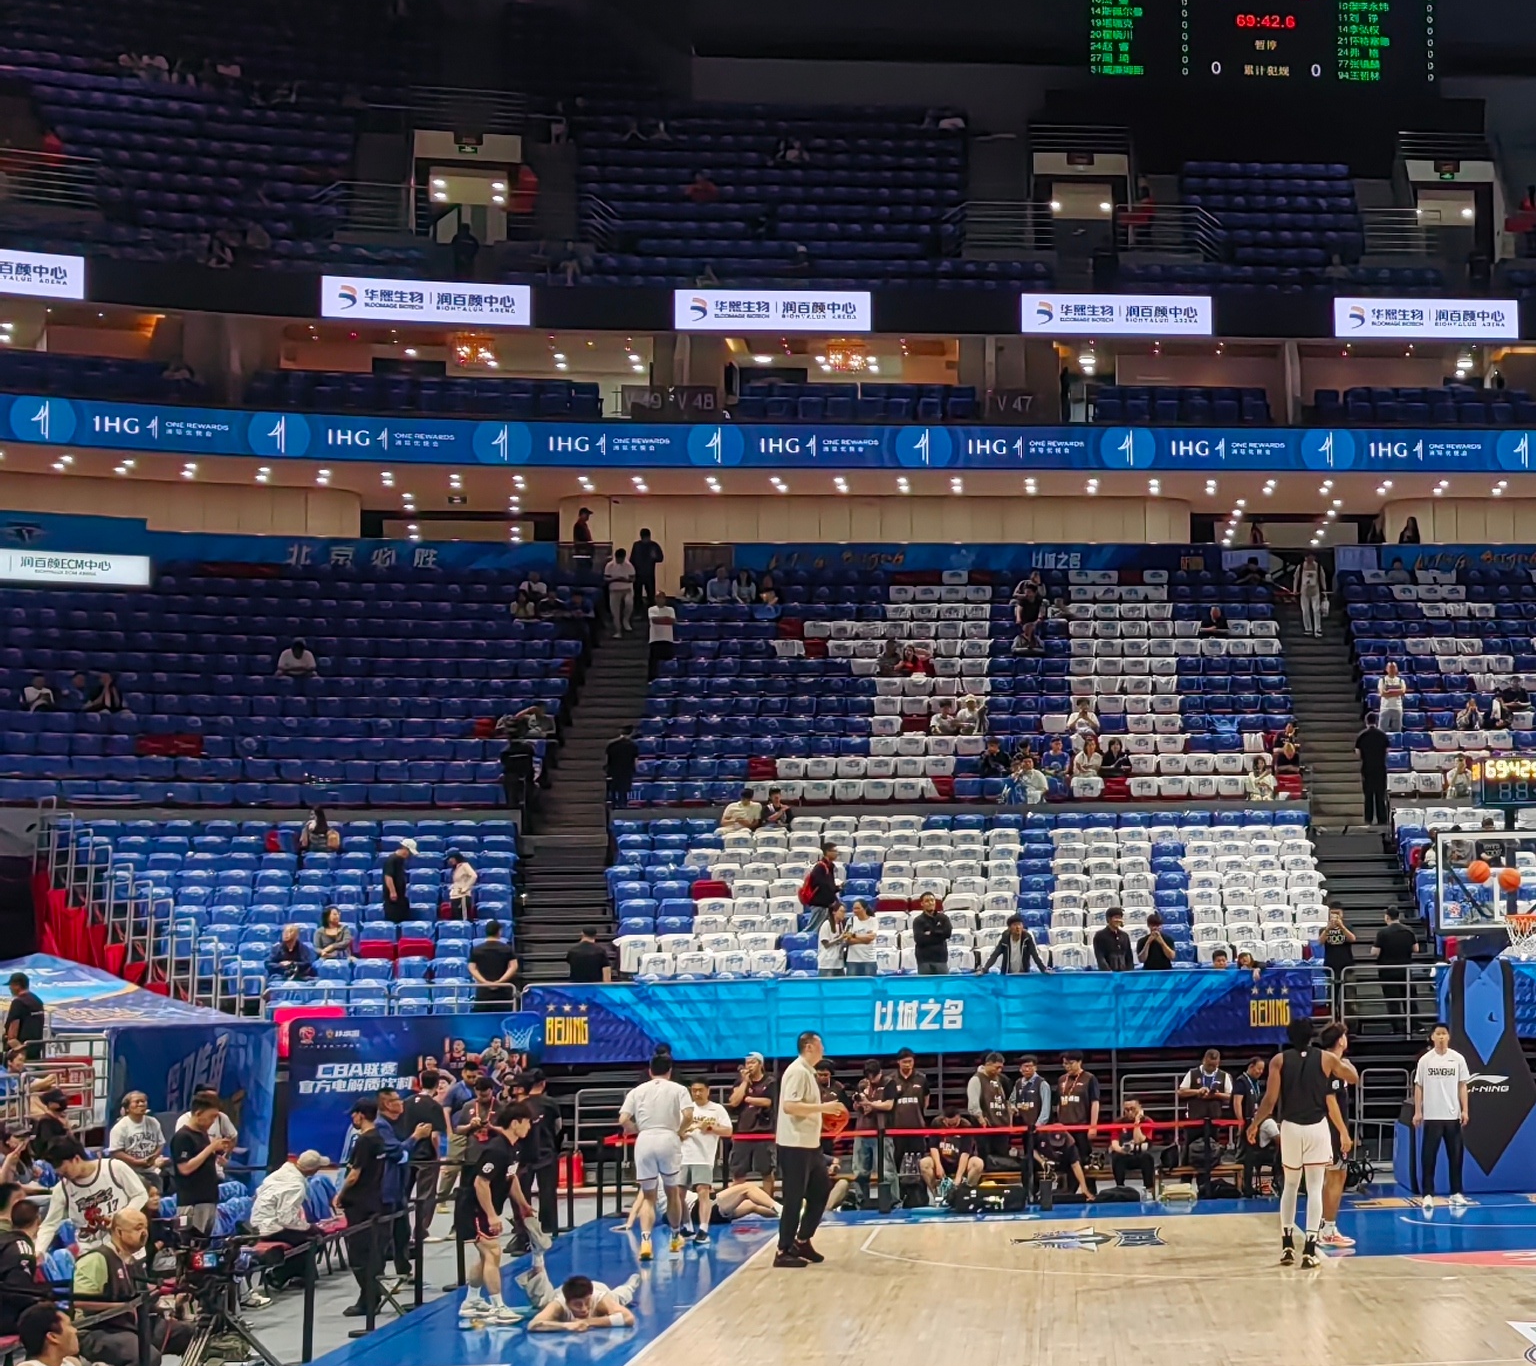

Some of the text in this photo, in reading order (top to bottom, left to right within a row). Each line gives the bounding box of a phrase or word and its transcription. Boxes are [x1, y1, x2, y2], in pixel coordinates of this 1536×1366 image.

[1236, 14, 1296, 29] 69:42.6
[1211, 61, 1222, 75] 0
[1311, 63, 1322, 78] 0
[364, 289, 515, 309] 华熙生物 润百颜中心
[714, 300, 857, 314] 华熙生物 润百颜中心
[1060, 304, 1198, 318] 华熙生物 润百颜中心
[1371, 308, 1505, 322] 华熙生物 润百颜中心
[93, 415, 140, 434] IHG
[327, 428, 370, 446] IHG
[548, 436, 590, 452] IHG
[759, 438, 800, 454] IHG
[968, 439, 1007, 455] IHG
[1171, 440, 1209, 456] IHG
[1369, 442, 1407, 458] IHG
[20, 555, 112, 572] 润百颜ECM中心
[286, 543, 438, 569] 北京必胜
[874, 998, 964, 1031] 以城之名
[1249, 998, 1291, 1027] BEIJING
[545, 1016, 589, 1045] BEIJING
[315, 1061, 399, 1079] CBA联赛
